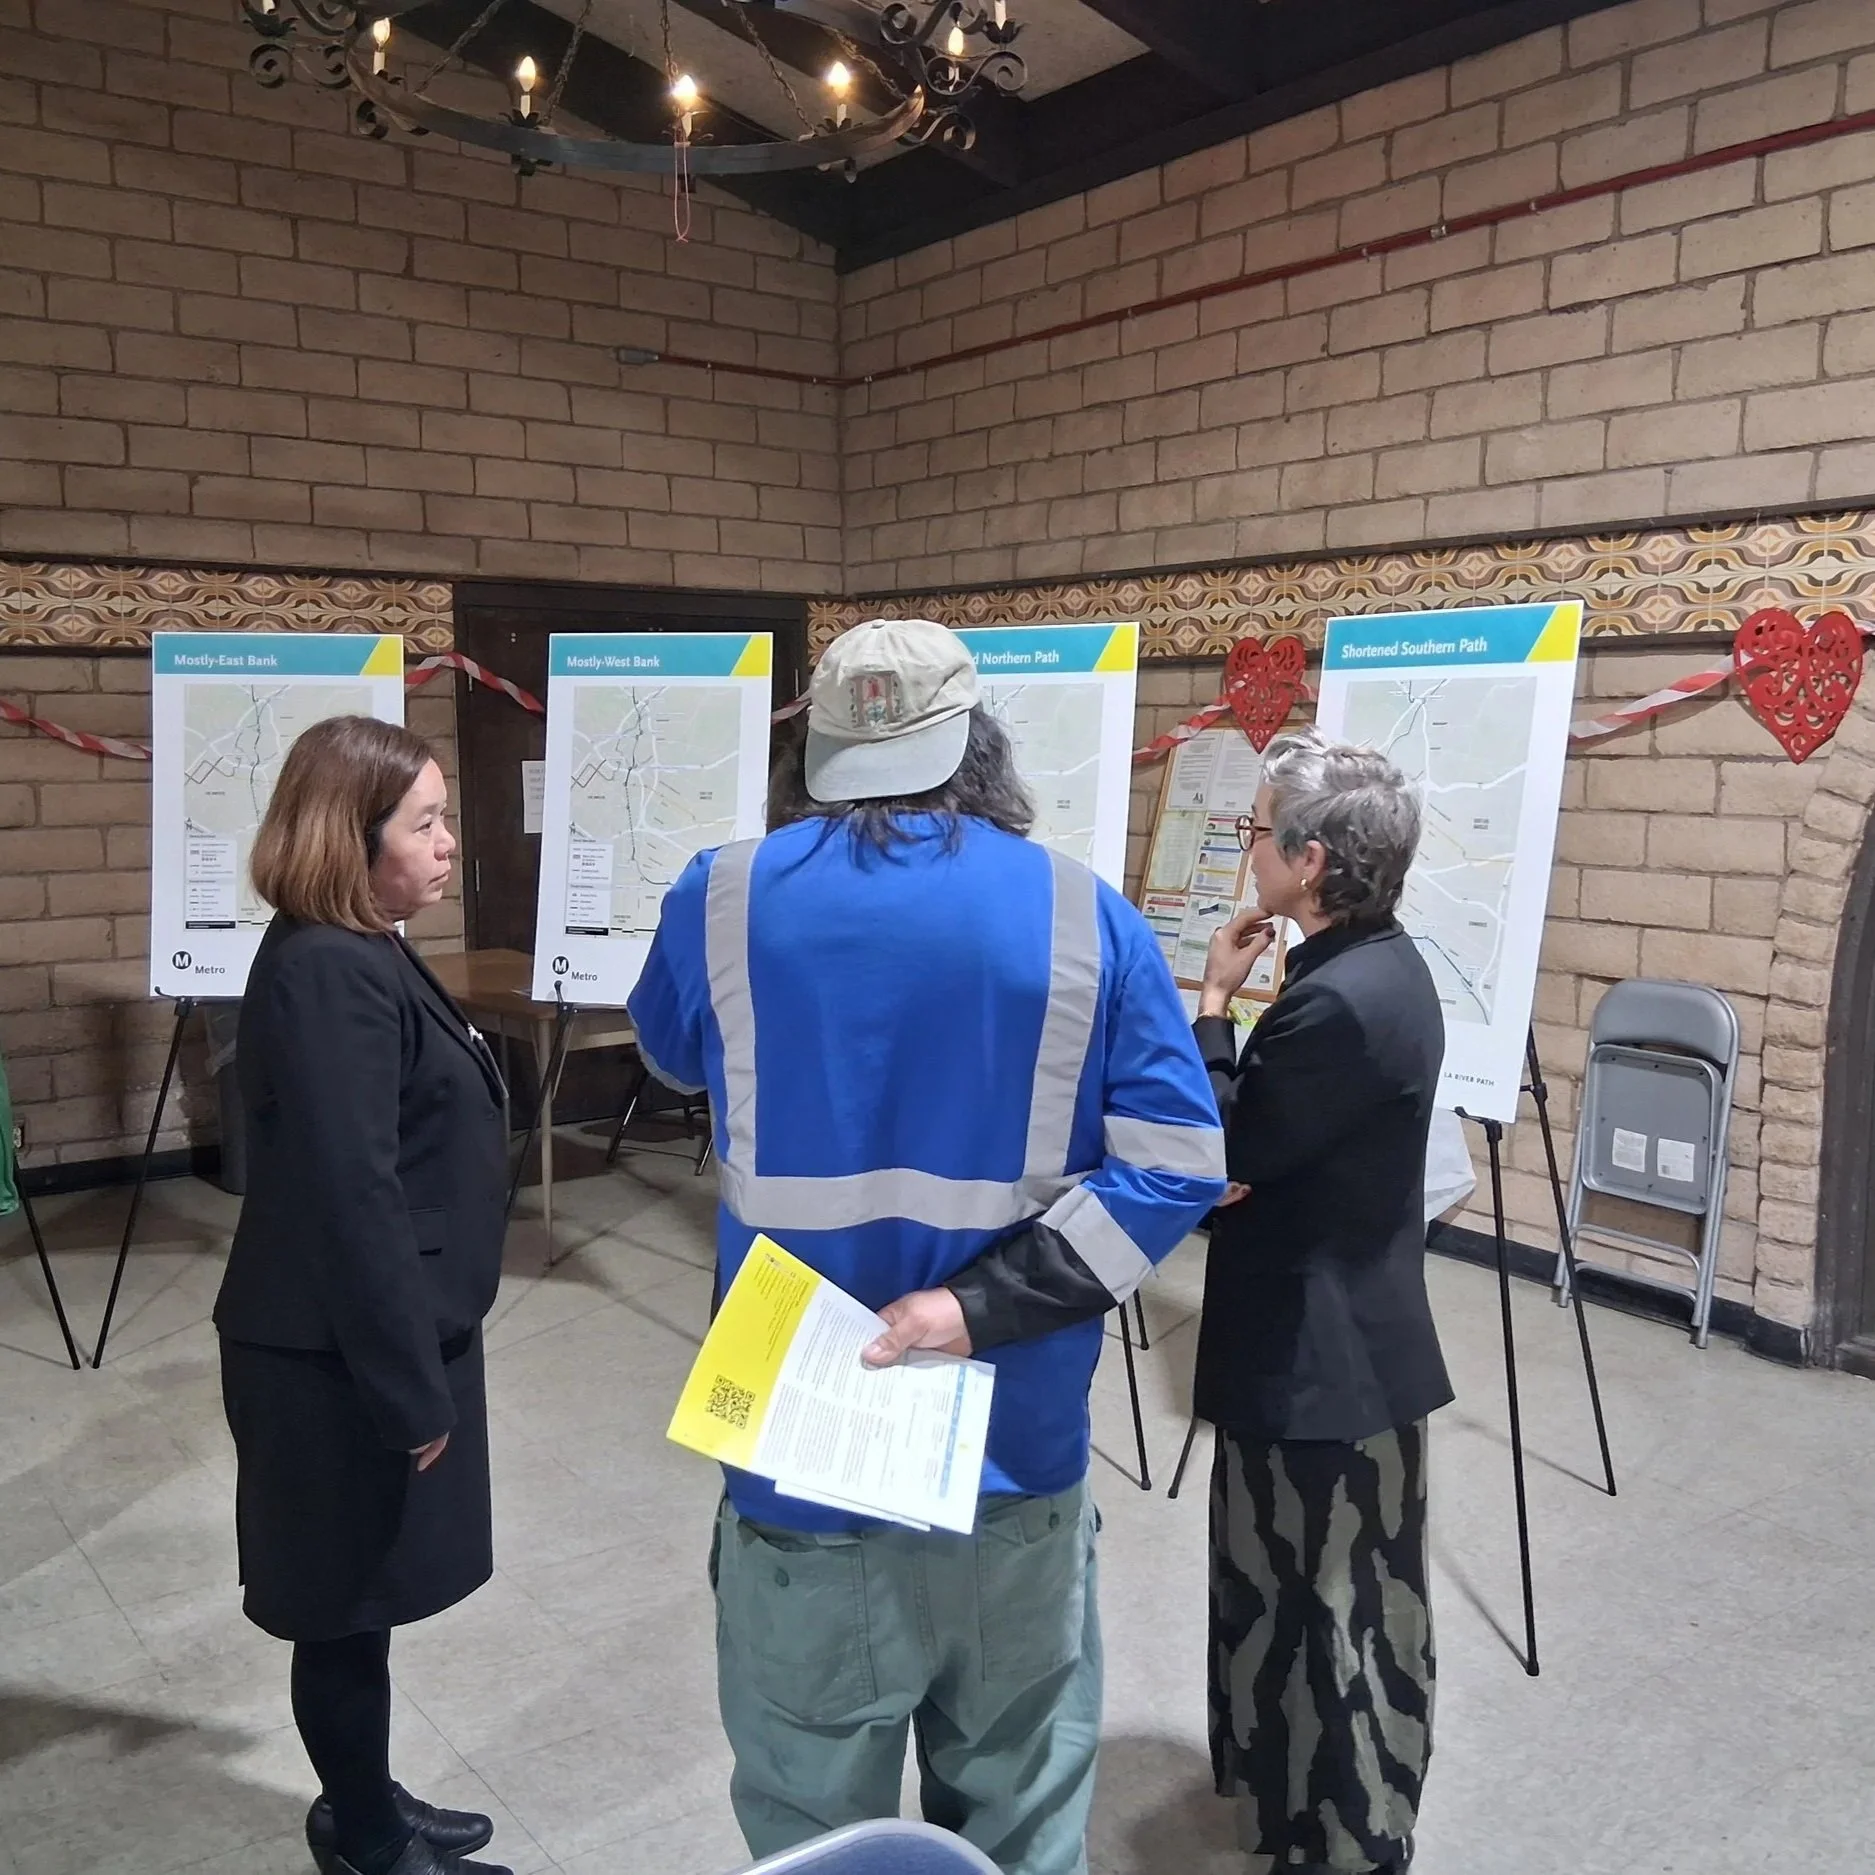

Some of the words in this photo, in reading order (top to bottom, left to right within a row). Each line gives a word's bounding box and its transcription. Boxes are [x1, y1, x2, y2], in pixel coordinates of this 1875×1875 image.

[1342, 641, 1398, 658] Shortened
[1400, 641, 1455, 656] Southern
[1459, 637, 1487, 653] Path
[174, 654, 244, 668] Mostly-East
[247, 655, 278, 667] Bank
[566, 655, 631, 671] Mostly-West
[633, 656, 660, 668] Bank
[982, 652, 1031, 665] Northern
[1034, 650, 1060, 664] Path
[195, 966, 226, 974] Metro
[571, 971, 598, 981] Metro
[1454, 1073, 1474, 1083] RIVER
[1476, 1078, 1495, 1086] PATH
